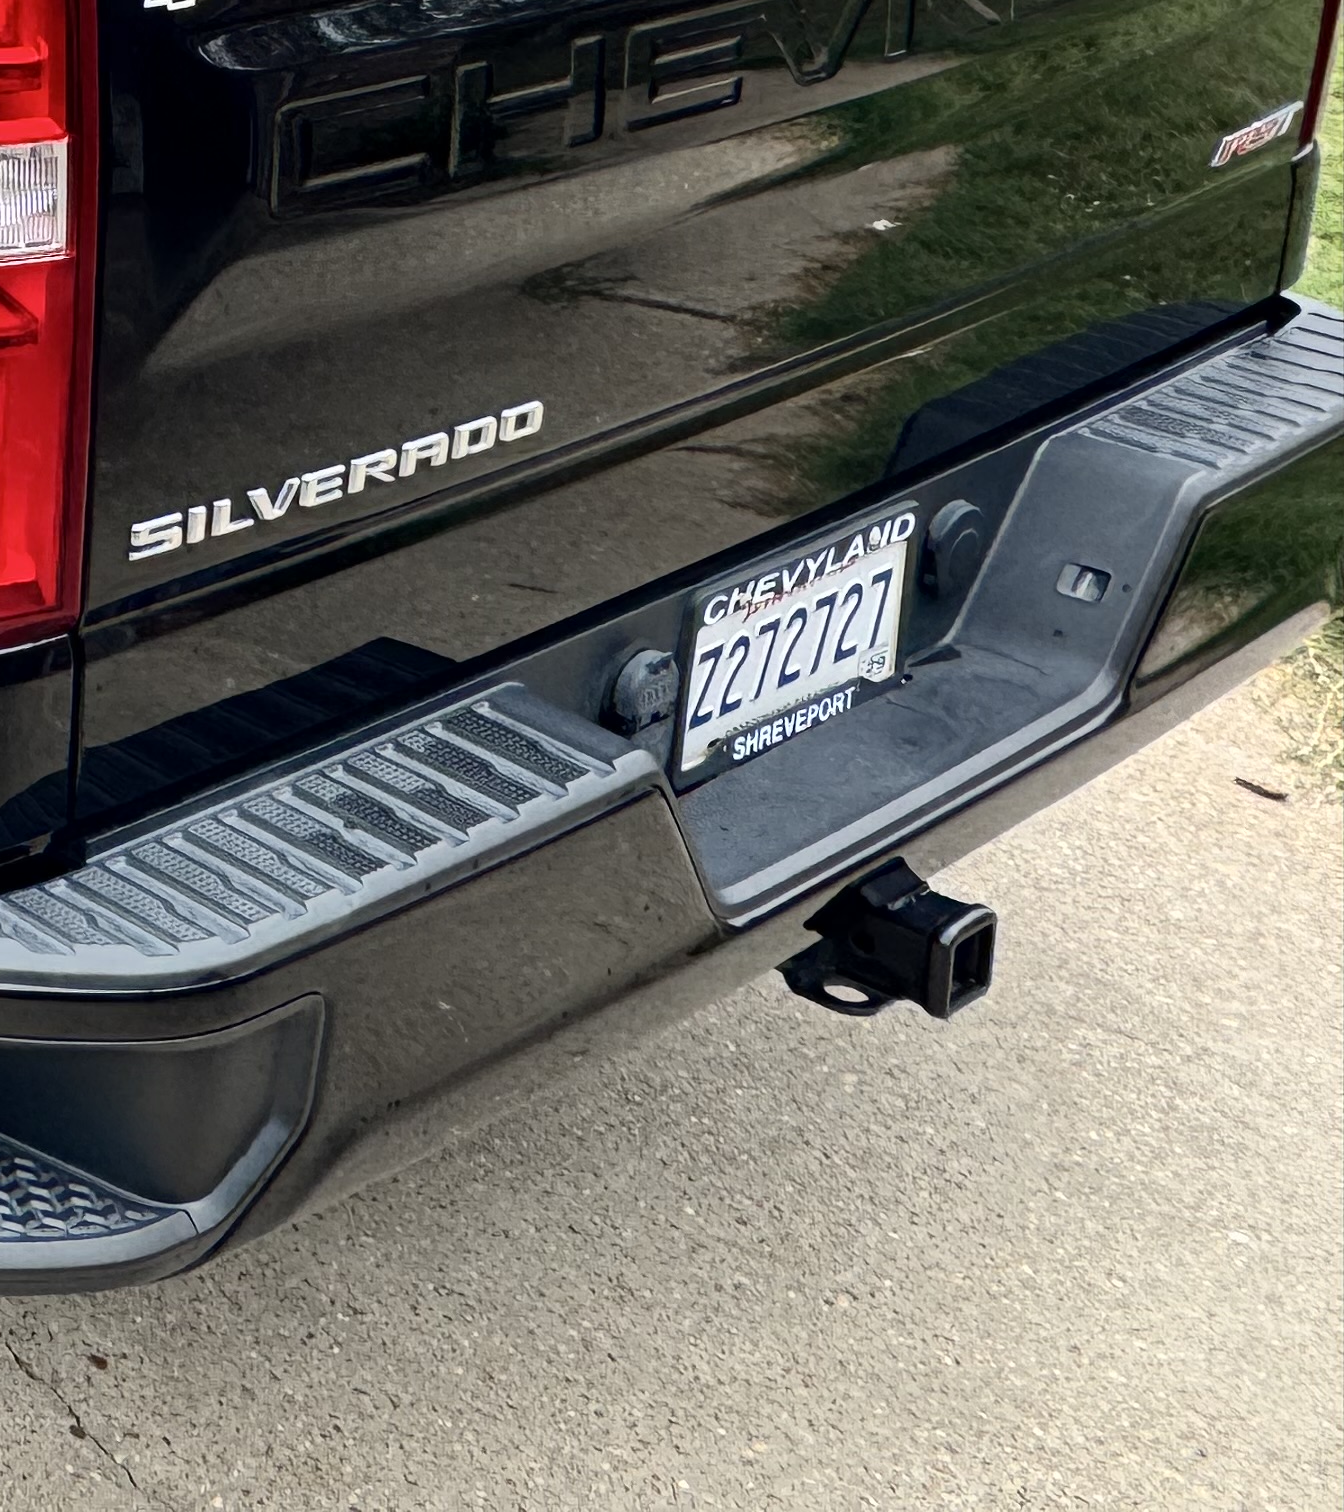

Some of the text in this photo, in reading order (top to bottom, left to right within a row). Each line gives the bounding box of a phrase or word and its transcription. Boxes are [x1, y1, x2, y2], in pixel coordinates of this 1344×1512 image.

[128, 400, 545, 562] SILVERADO
[688, 564, 894, 730] Z272727
[732, 686, 857, 761] SHREVEPORT
